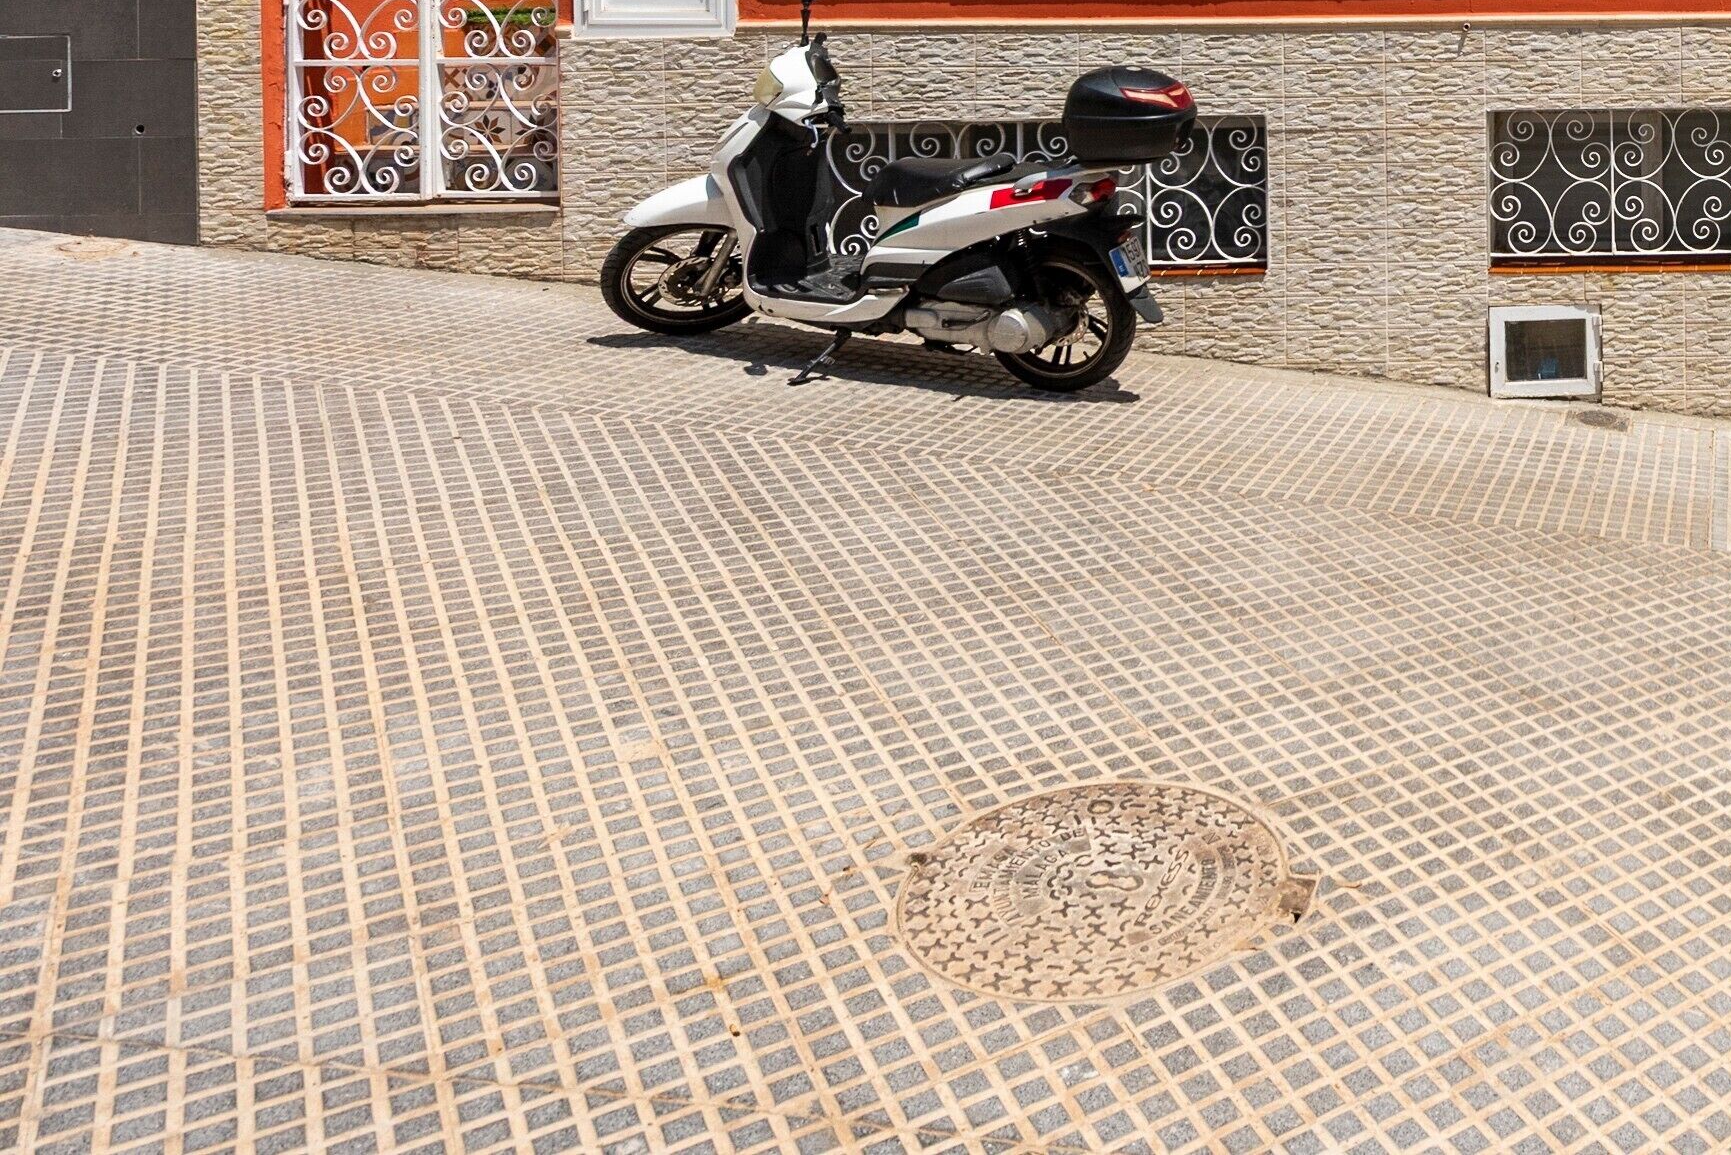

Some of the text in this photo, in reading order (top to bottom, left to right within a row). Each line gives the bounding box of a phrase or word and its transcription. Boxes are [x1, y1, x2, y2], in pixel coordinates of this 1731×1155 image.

[993, 827, 1086, 923] AYUNTAMIENTO DE
[1022, 849, 1068, 900] MALAGA
[1148, 855, 1217, 935] SANEAMIENTO
